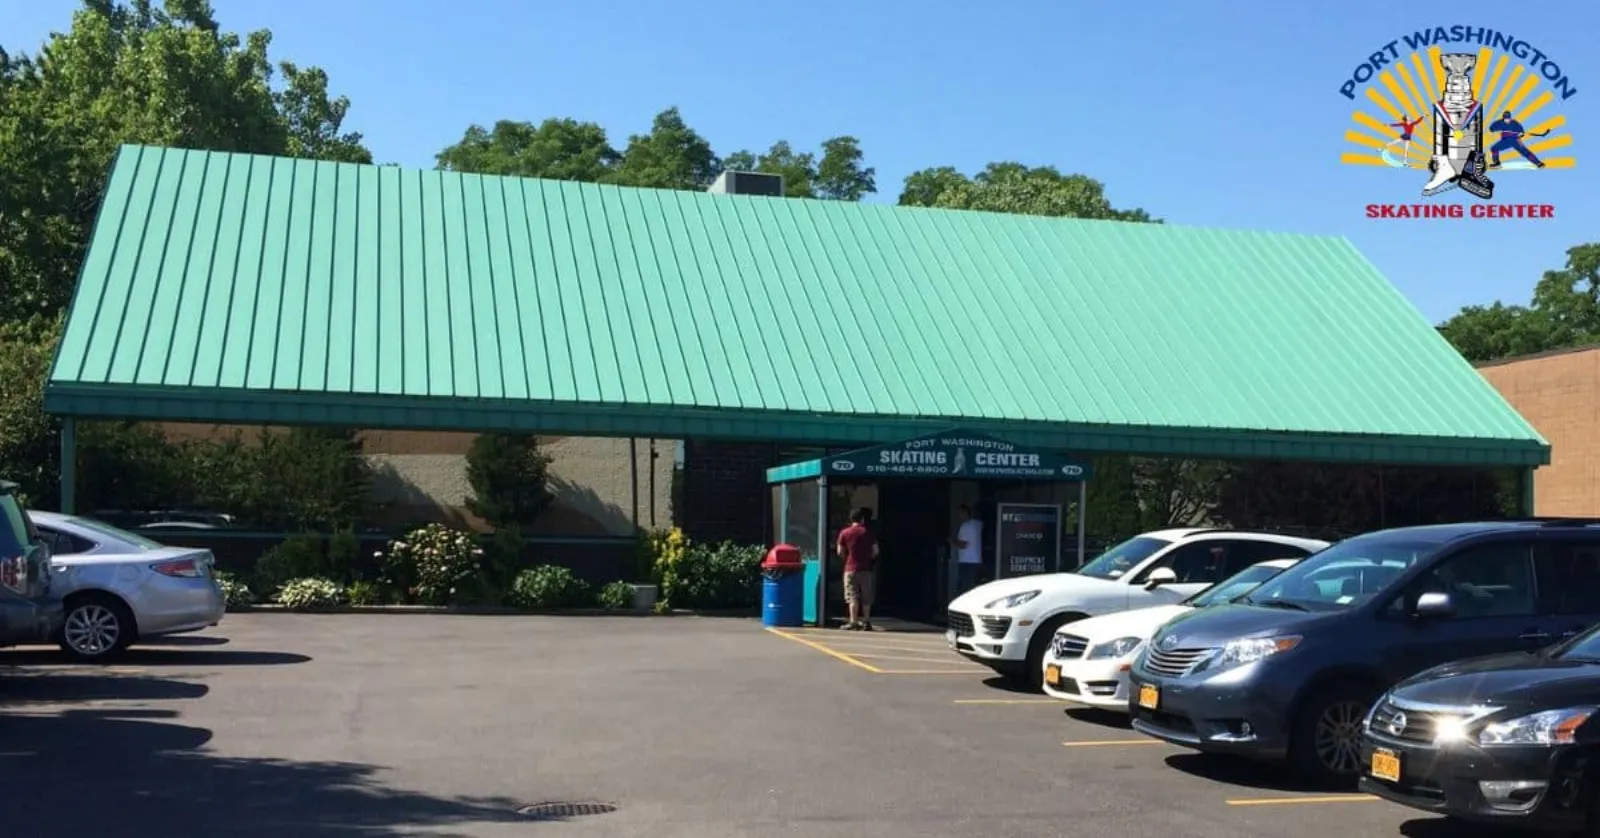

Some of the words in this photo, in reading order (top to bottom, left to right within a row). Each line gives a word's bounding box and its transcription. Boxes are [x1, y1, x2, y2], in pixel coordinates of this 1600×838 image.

[906, 439, 936, 449] PORT
[942, 437, 1015, 452] WASHINGTON
[880, 451, 947, 464] SKATING
[975, 453, 1040, 466] CENTER
